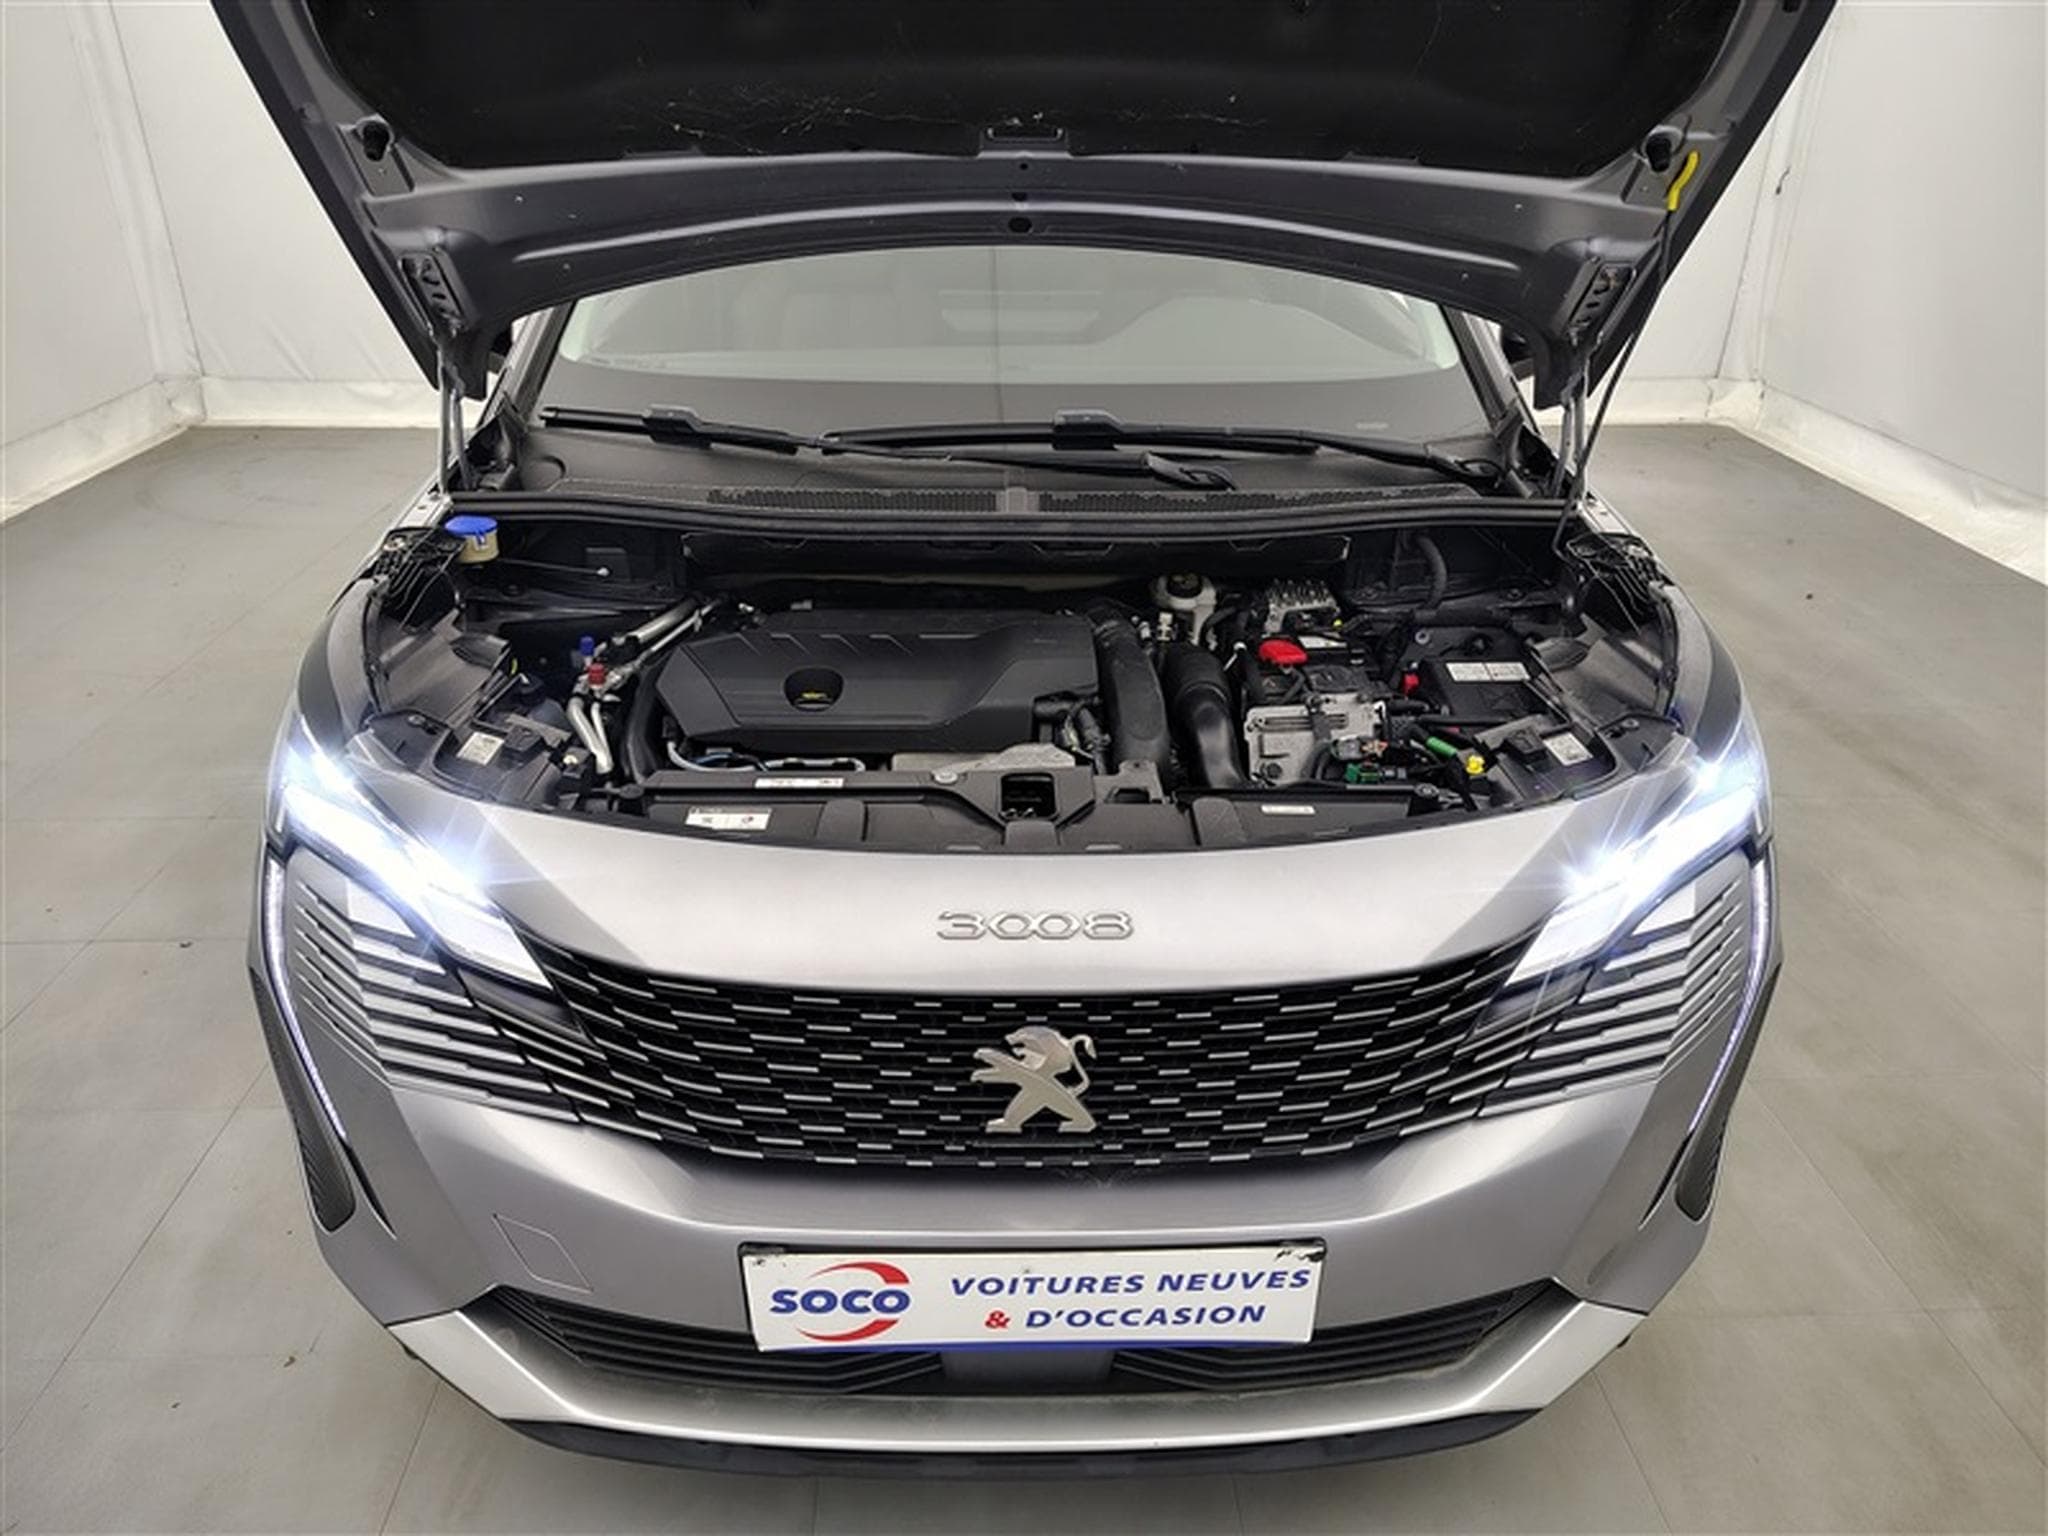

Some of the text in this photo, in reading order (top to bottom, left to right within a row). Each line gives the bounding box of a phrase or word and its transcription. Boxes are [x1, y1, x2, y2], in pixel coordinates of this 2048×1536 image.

[937, 911, 1134, 941] 3008
[950, 1268, 1312, 1296] VOITURES NEUVES
[770, 1288, 911, 1315] SOCO
[984, 1303, 1267, 1329] & D'OCCASION
